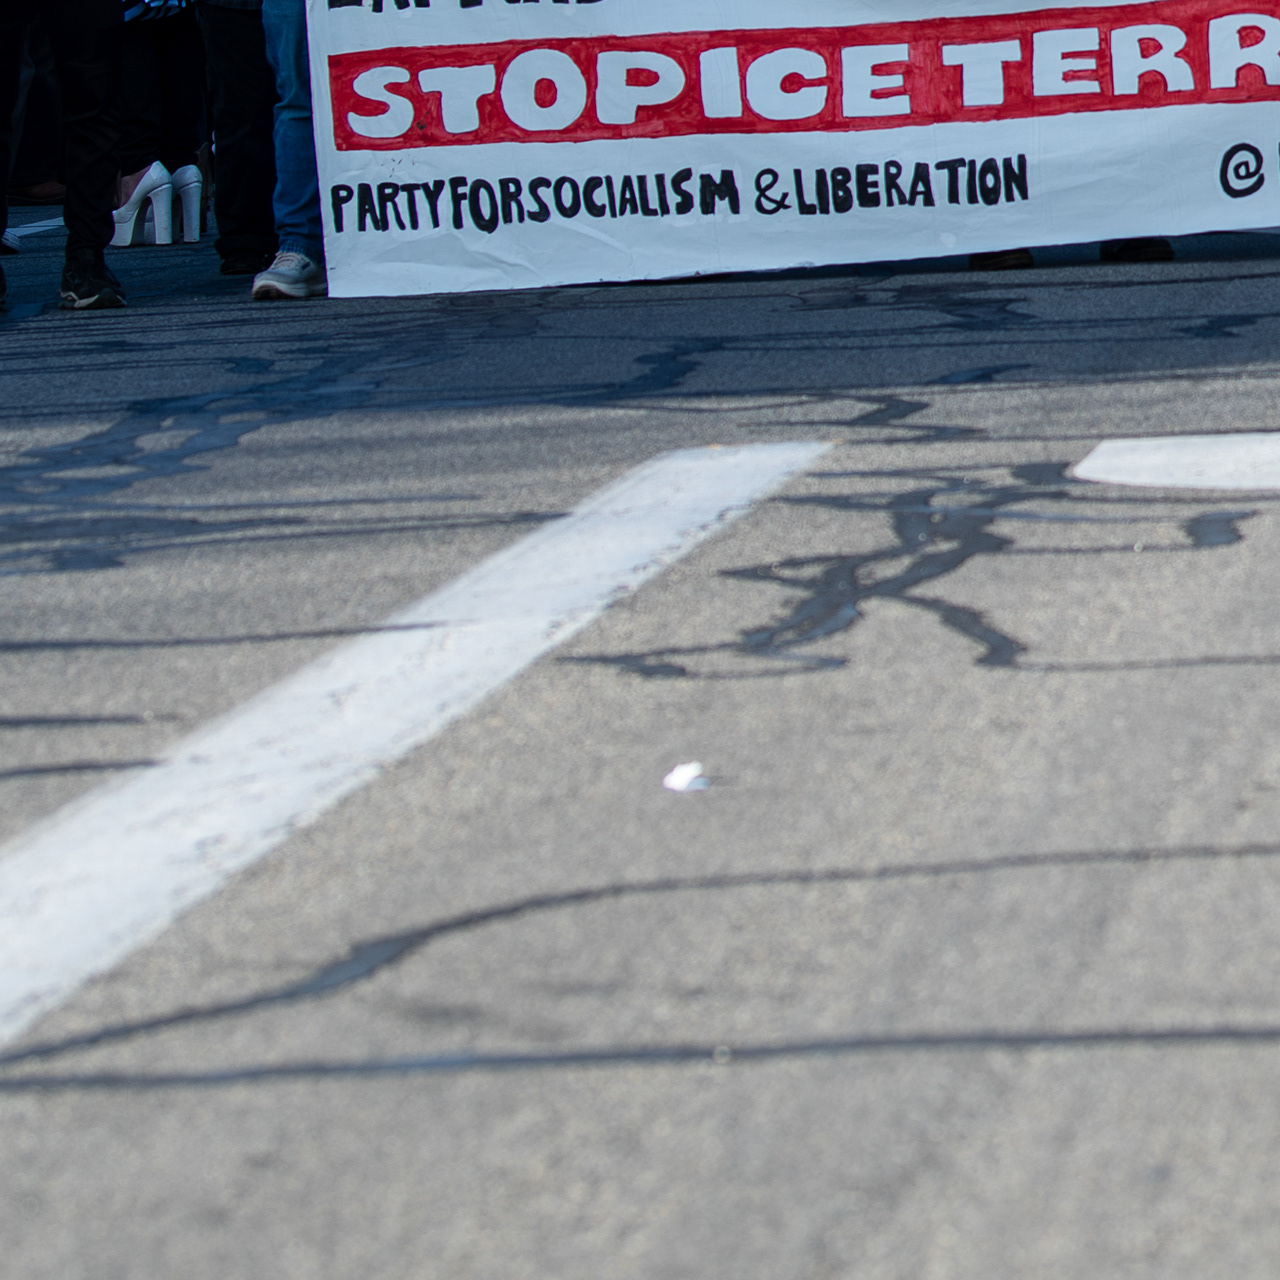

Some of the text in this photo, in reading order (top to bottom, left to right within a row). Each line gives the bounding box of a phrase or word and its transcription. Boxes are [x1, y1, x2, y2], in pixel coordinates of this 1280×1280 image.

[346, 46, 687, 140] STOP
[700, 43, 912, 122] ICE
[330, 154, 1030, 235] PARTY FOR SOCIALISM & LIBERATION
